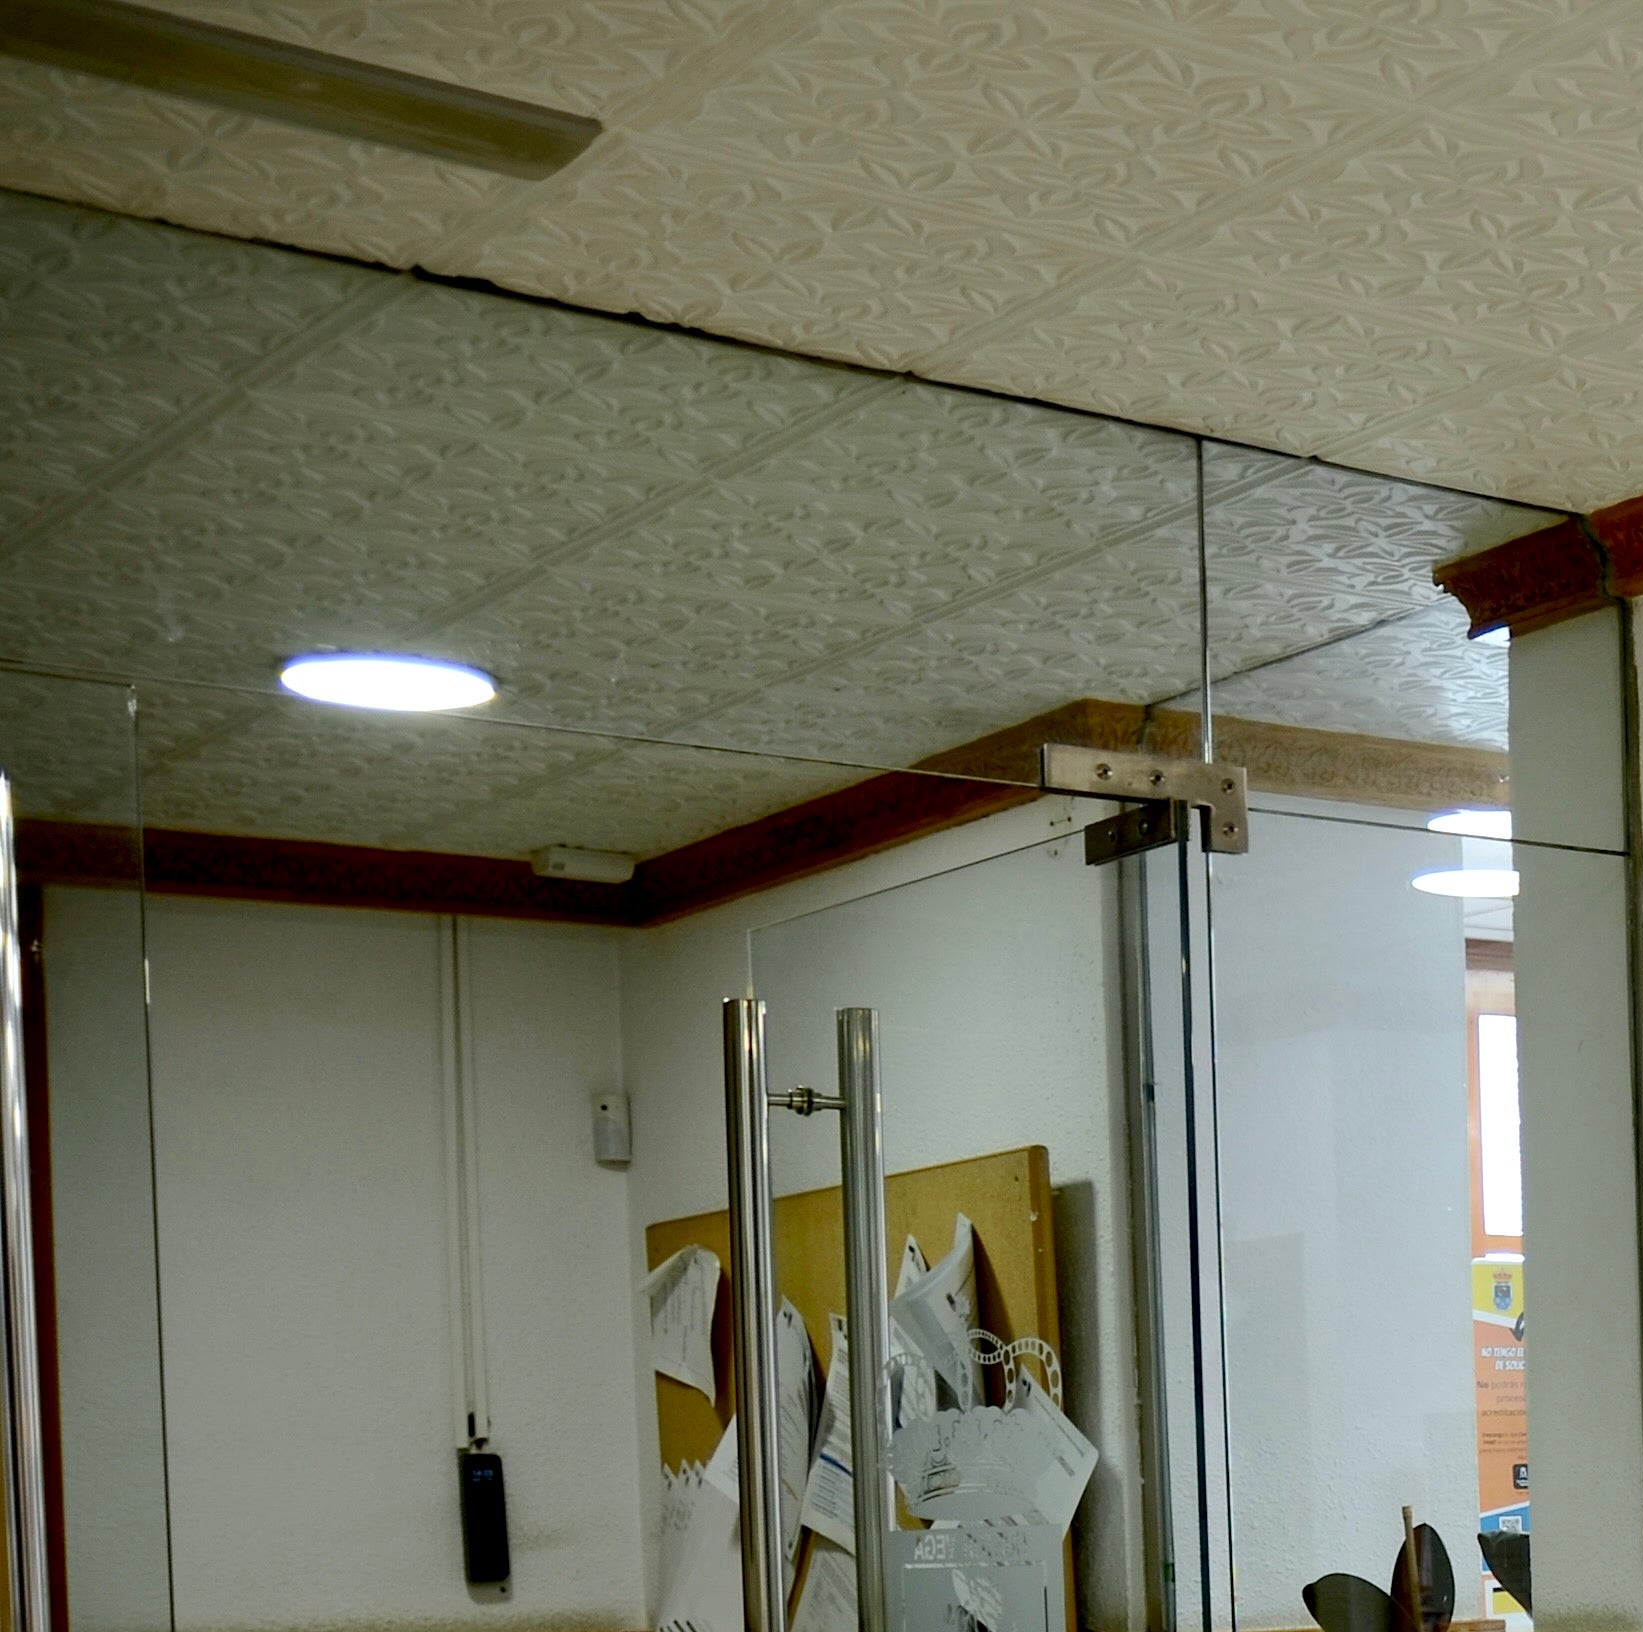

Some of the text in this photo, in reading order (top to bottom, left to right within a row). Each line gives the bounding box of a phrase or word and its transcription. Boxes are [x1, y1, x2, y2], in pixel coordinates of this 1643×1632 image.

[1480, 1347, 1515, 1358] NO TENGO
[1494, 1360, 1505, 1371] DE
